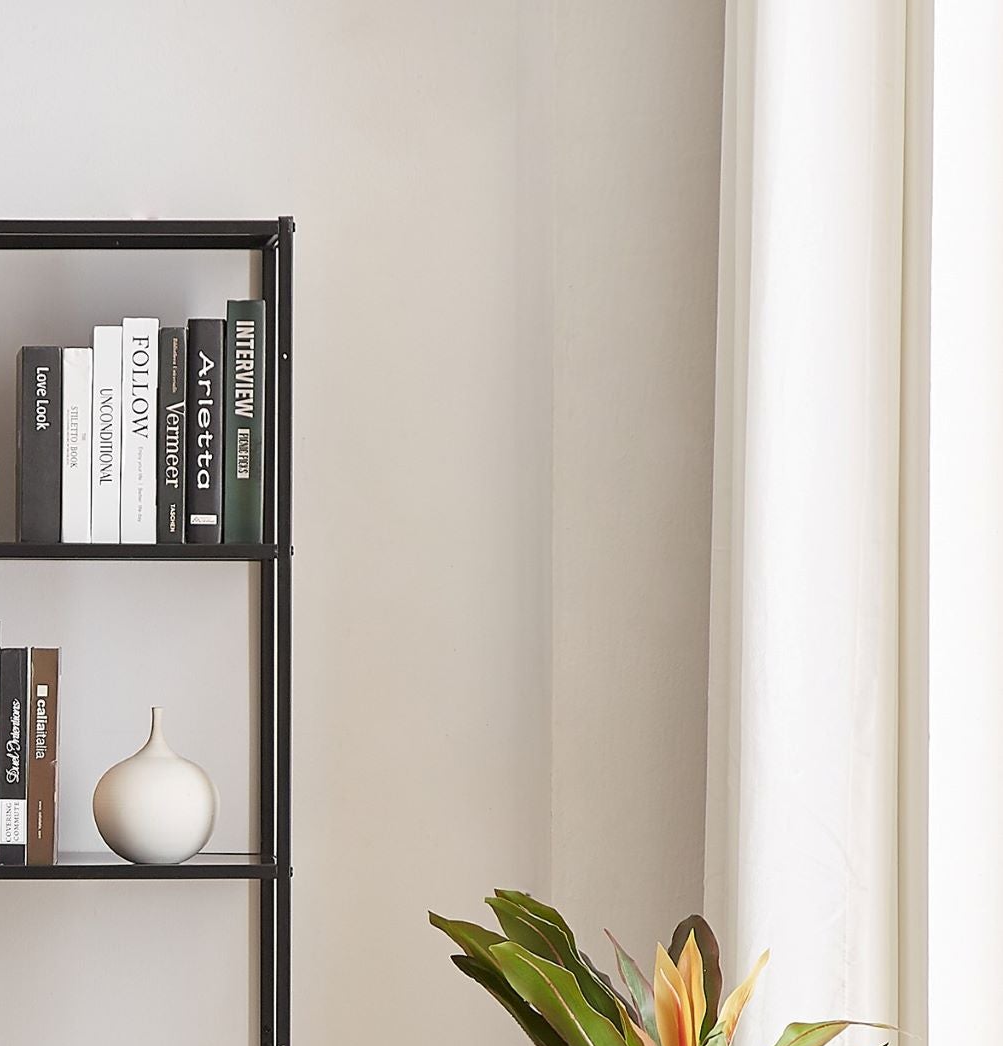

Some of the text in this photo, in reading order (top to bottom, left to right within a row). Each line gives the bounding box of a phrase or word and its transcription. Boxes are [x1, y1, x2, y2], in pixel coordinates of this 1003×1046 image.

[35, 366, 50, 431] Love Look
[131, 335, 150, 439] FOLLOW
[235, 320, 255, 418] INTERVIEW
[70, 405, 79, 469] STILETTO BOOK
[98, 388, 114, 486] UNCONDITIONAL
[165, 401, 186, 489] Vermeer
[197, 350, 215, 490] Arletta
